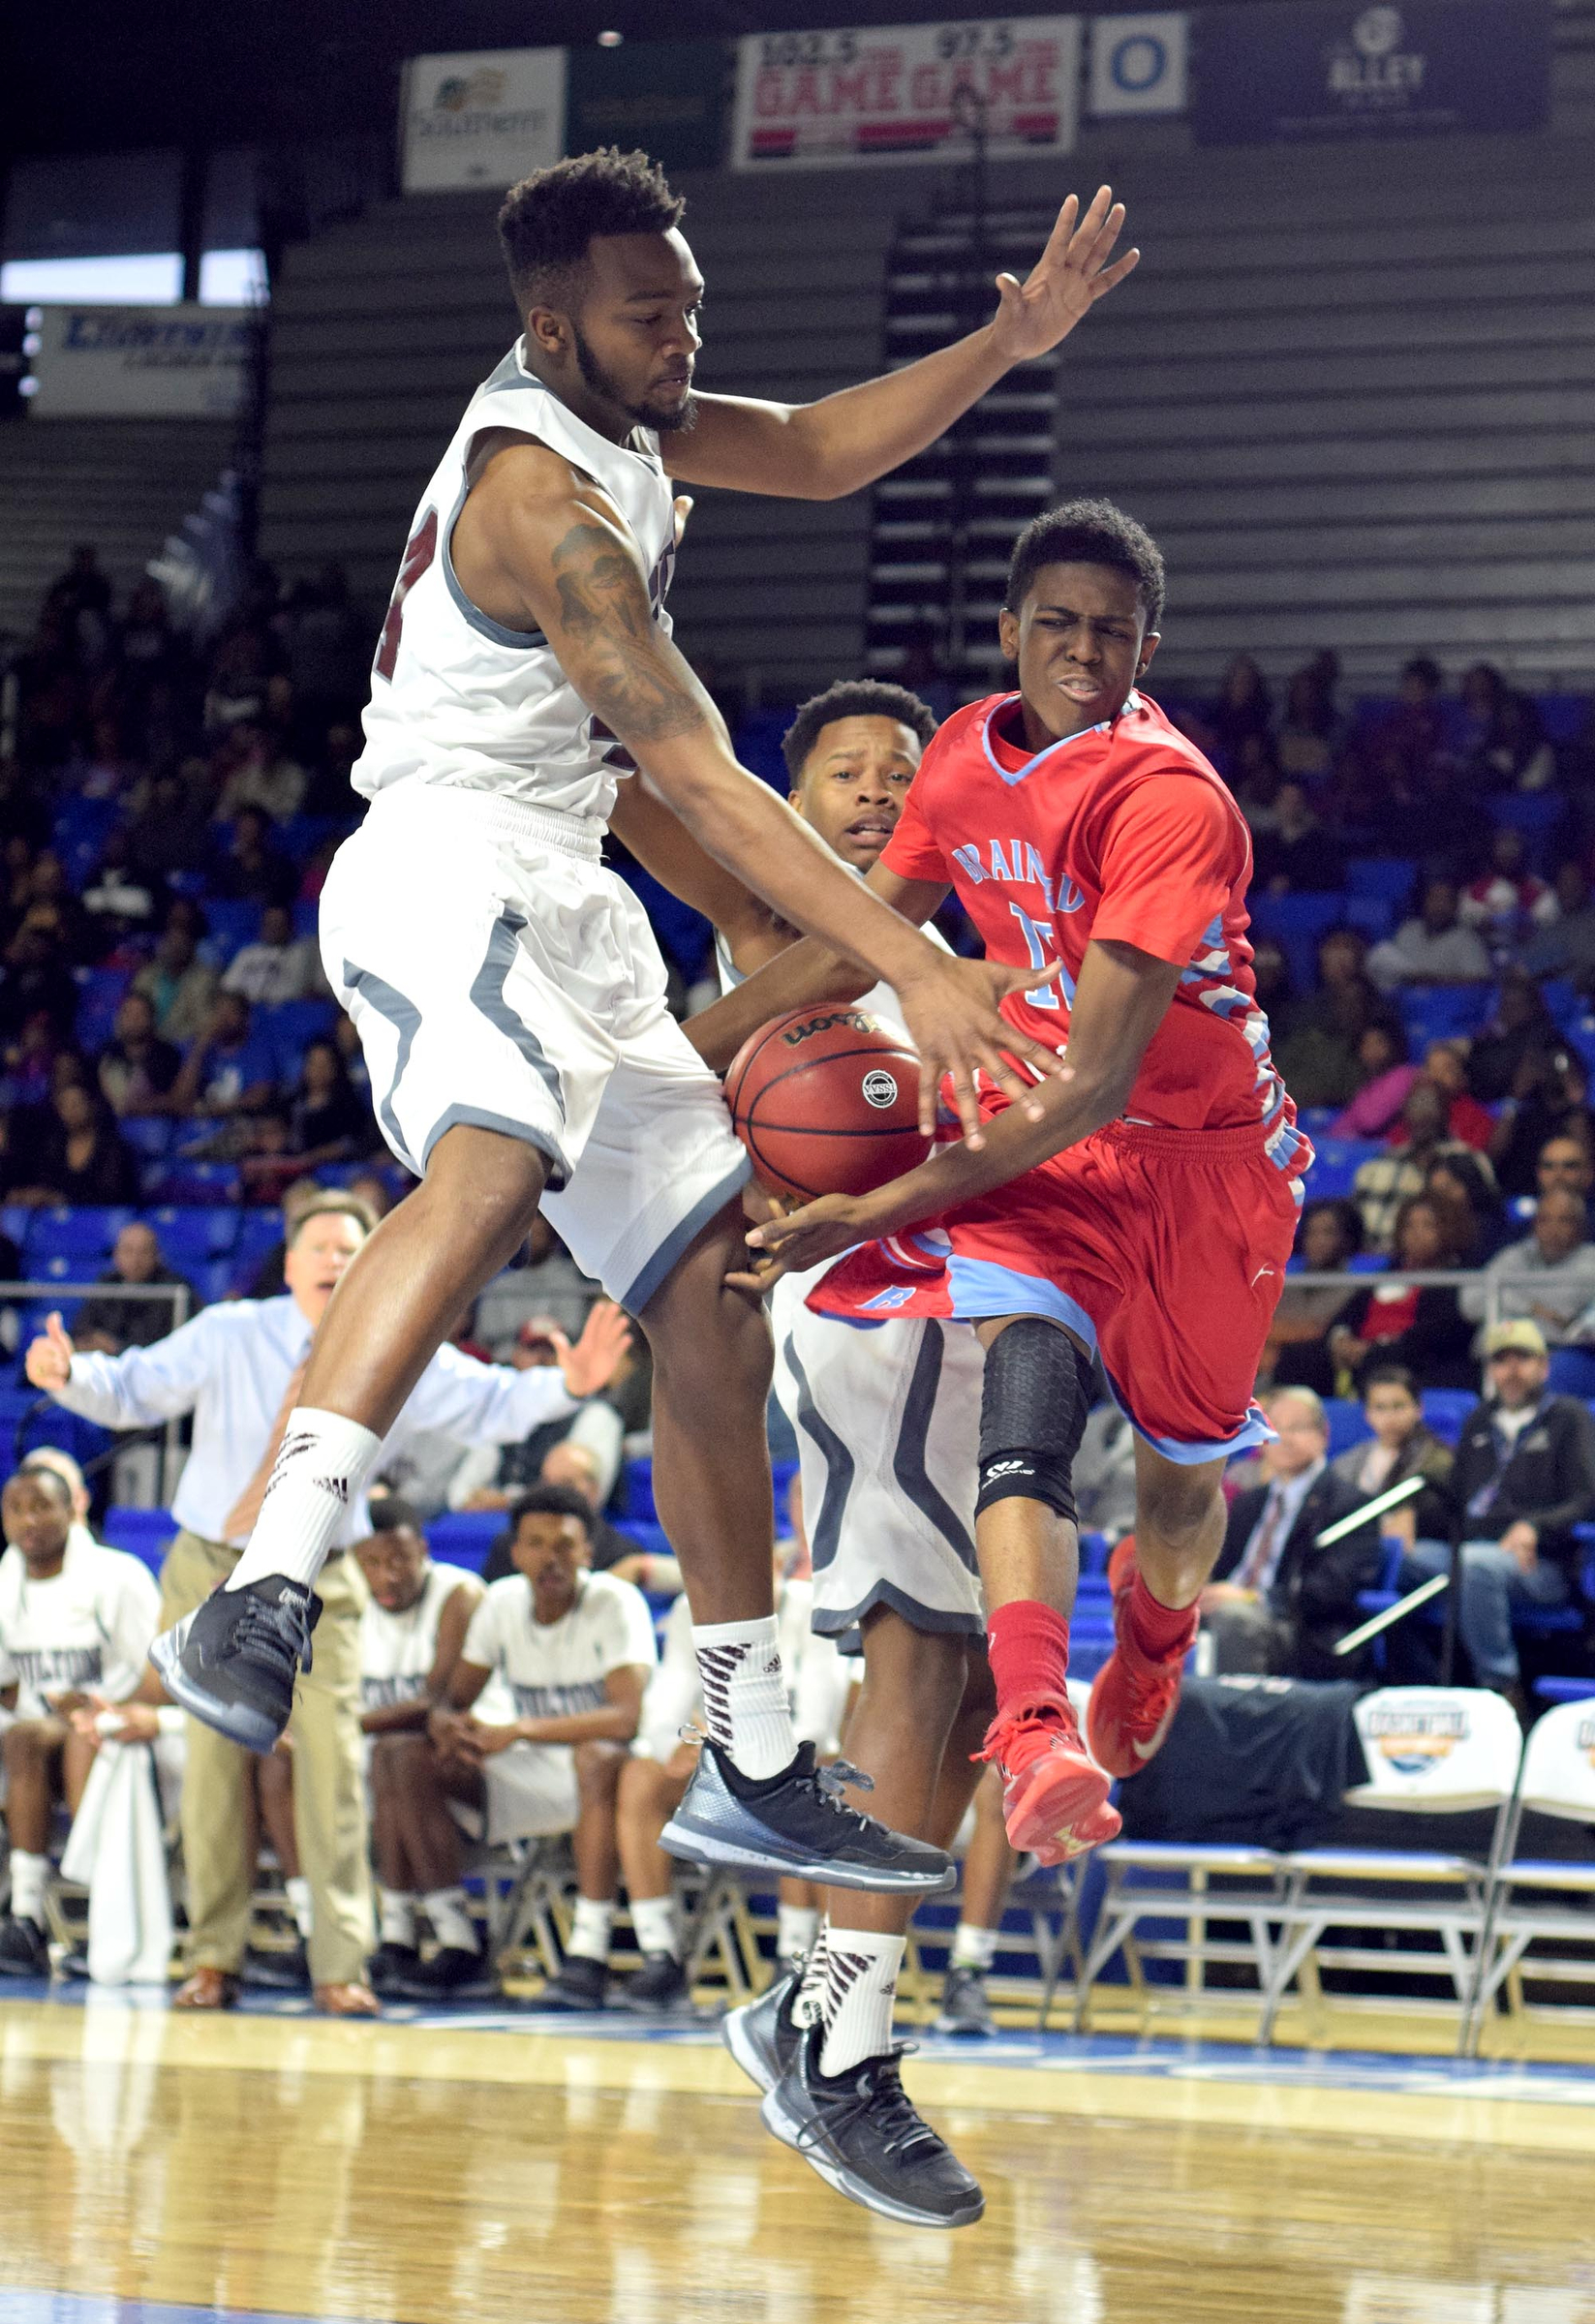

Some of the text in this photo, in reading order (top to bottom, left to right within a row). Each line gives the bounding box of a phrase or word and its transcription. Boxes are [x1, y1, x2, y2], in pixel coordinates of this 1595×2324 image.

[753, 62, 901, 116] GAME
[910, 55, 1058, 109] GAME
[863, 1084, 897, 1094] TSSAA
[854, 1285, 917, 1310] B
